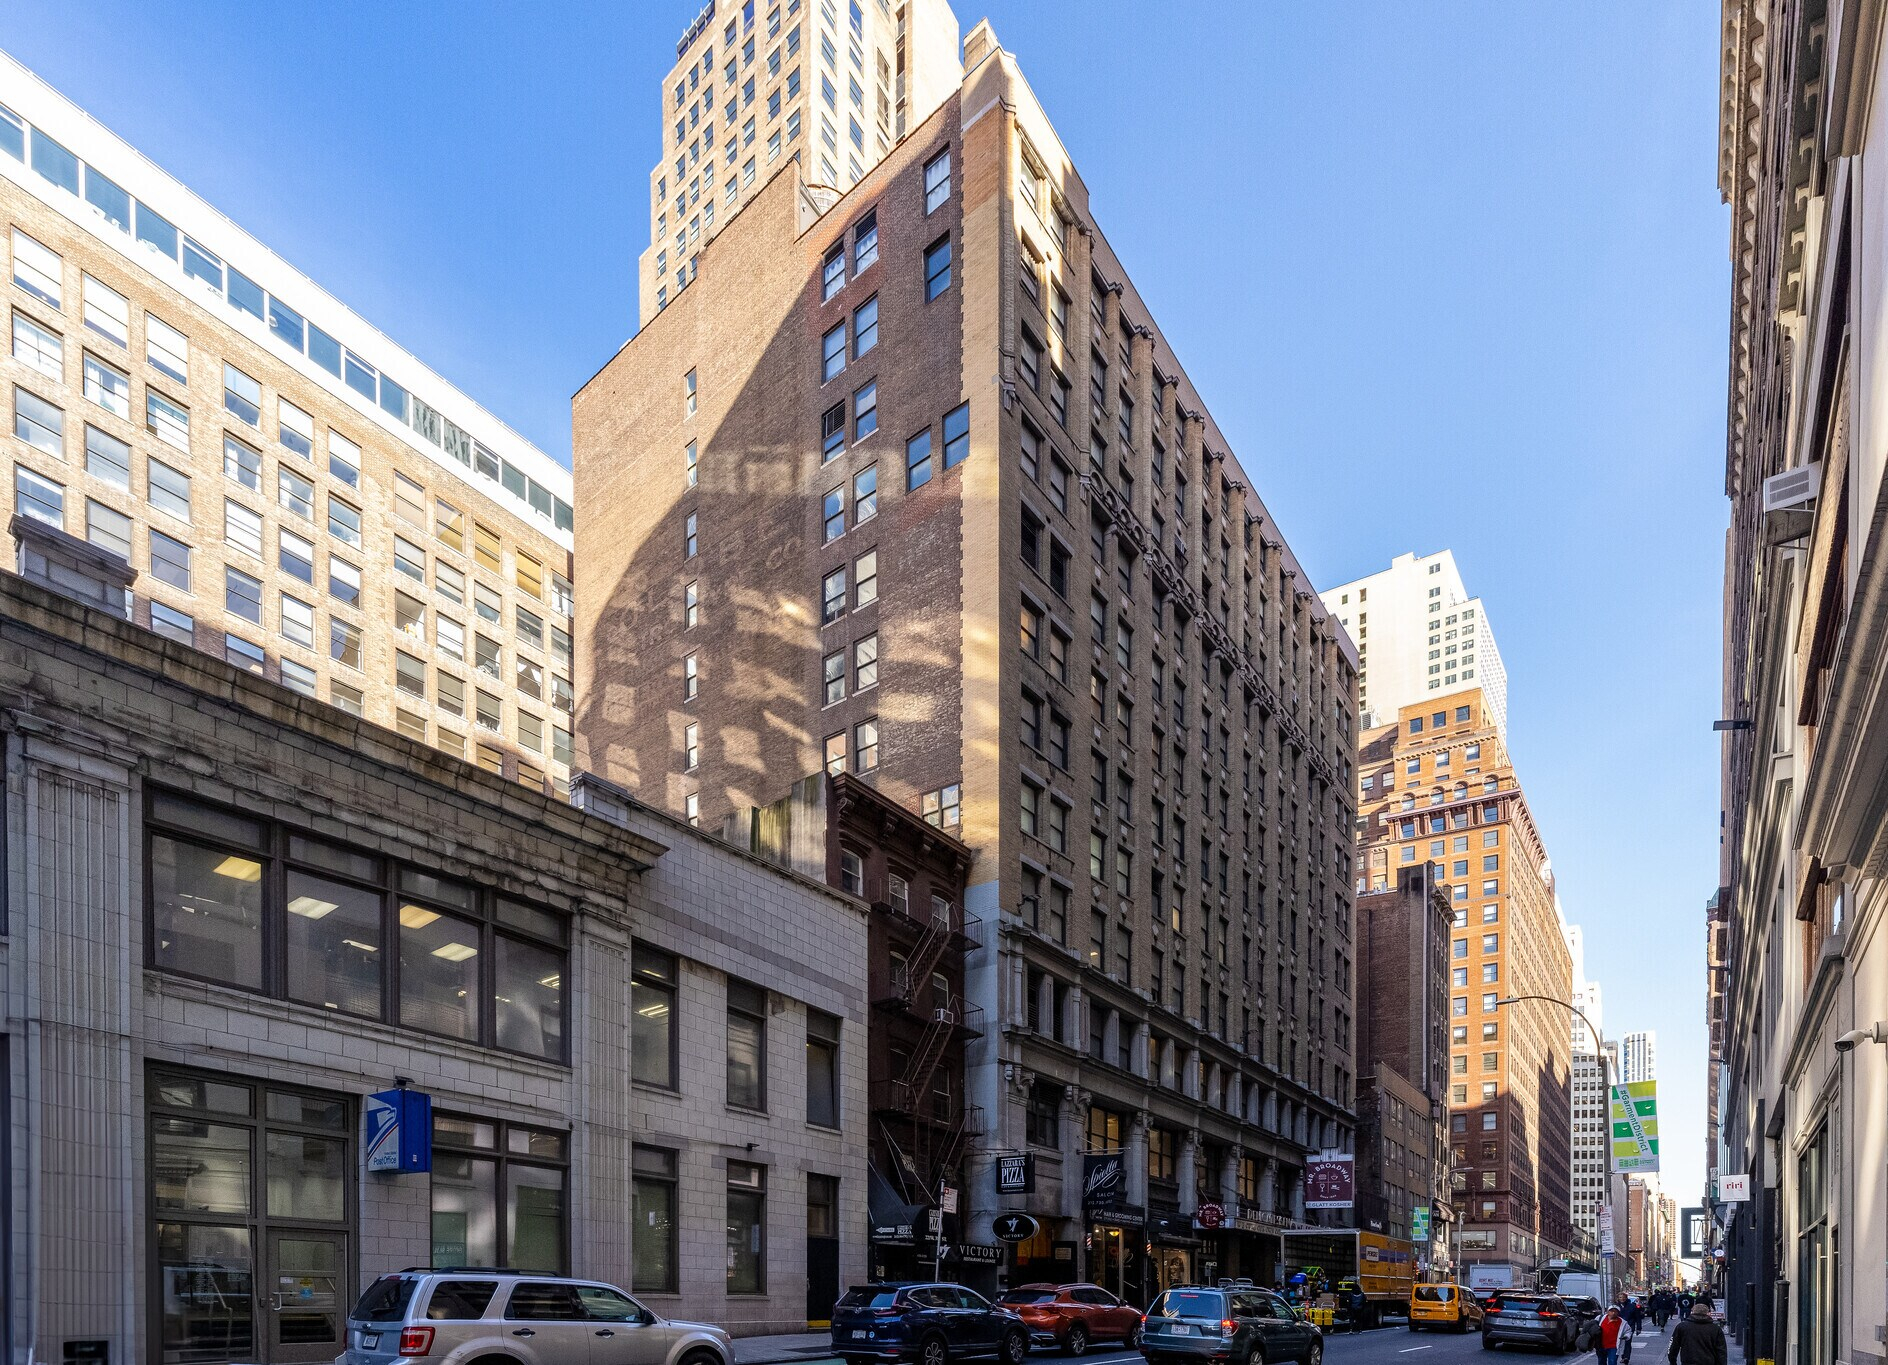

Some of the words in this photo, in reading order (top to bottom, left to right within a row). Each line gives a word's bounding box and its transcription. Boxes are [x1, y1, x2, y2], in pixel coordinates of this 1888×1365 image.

[1620, 1089, 1648, 1152] #GarmentDistrict
[1001, 1166, 1025, 1183] PIZZA
[1307, 1172, 1316, 1185] MR.
[1315, 1162, 1351, 1183] BROADWAY
[1726, 1181, 1743, 1190] riri
[959, 1244, 1002, 1258] VICTORY
